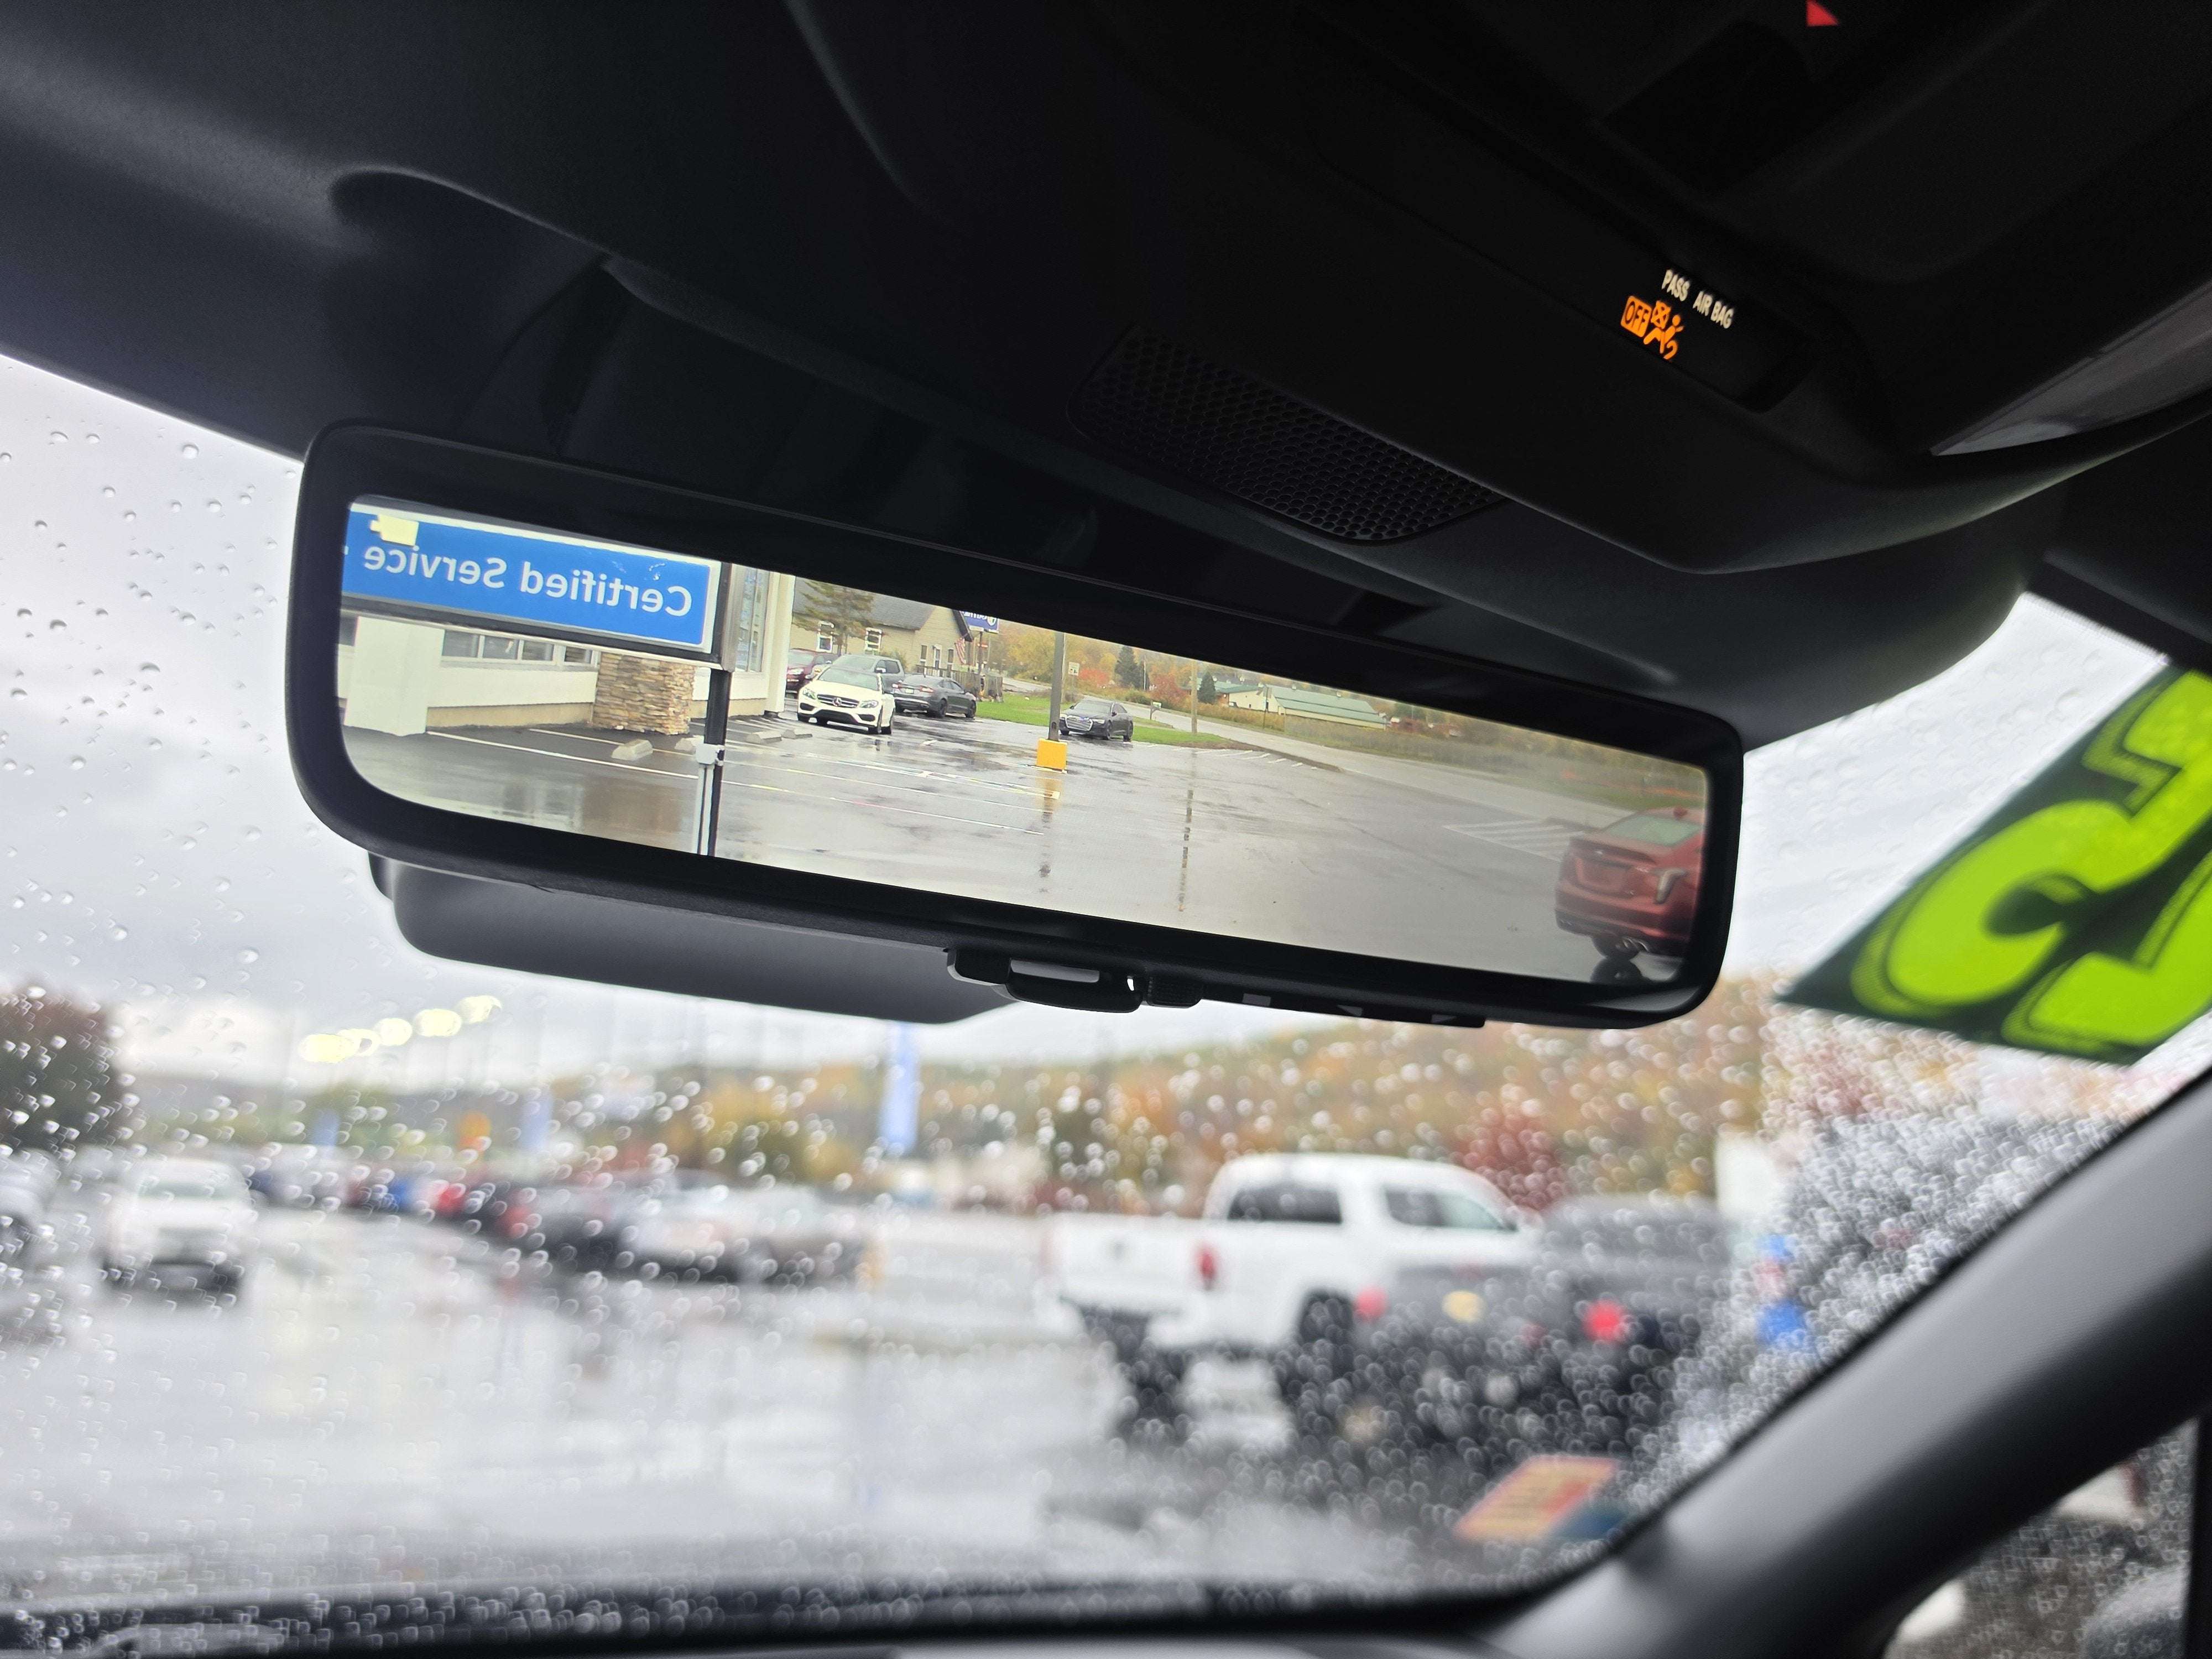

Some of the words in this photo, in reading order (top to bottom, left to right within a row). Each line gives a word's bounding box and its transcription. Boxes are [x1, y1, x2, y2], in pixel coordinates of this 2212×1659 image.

[1624, 300, 1650, 332] OFF
[1661, 269, 1691, 301] PASS
[1692, 290, 1713, 316] AIR
[1710, 300, 1734, 329] BAG
